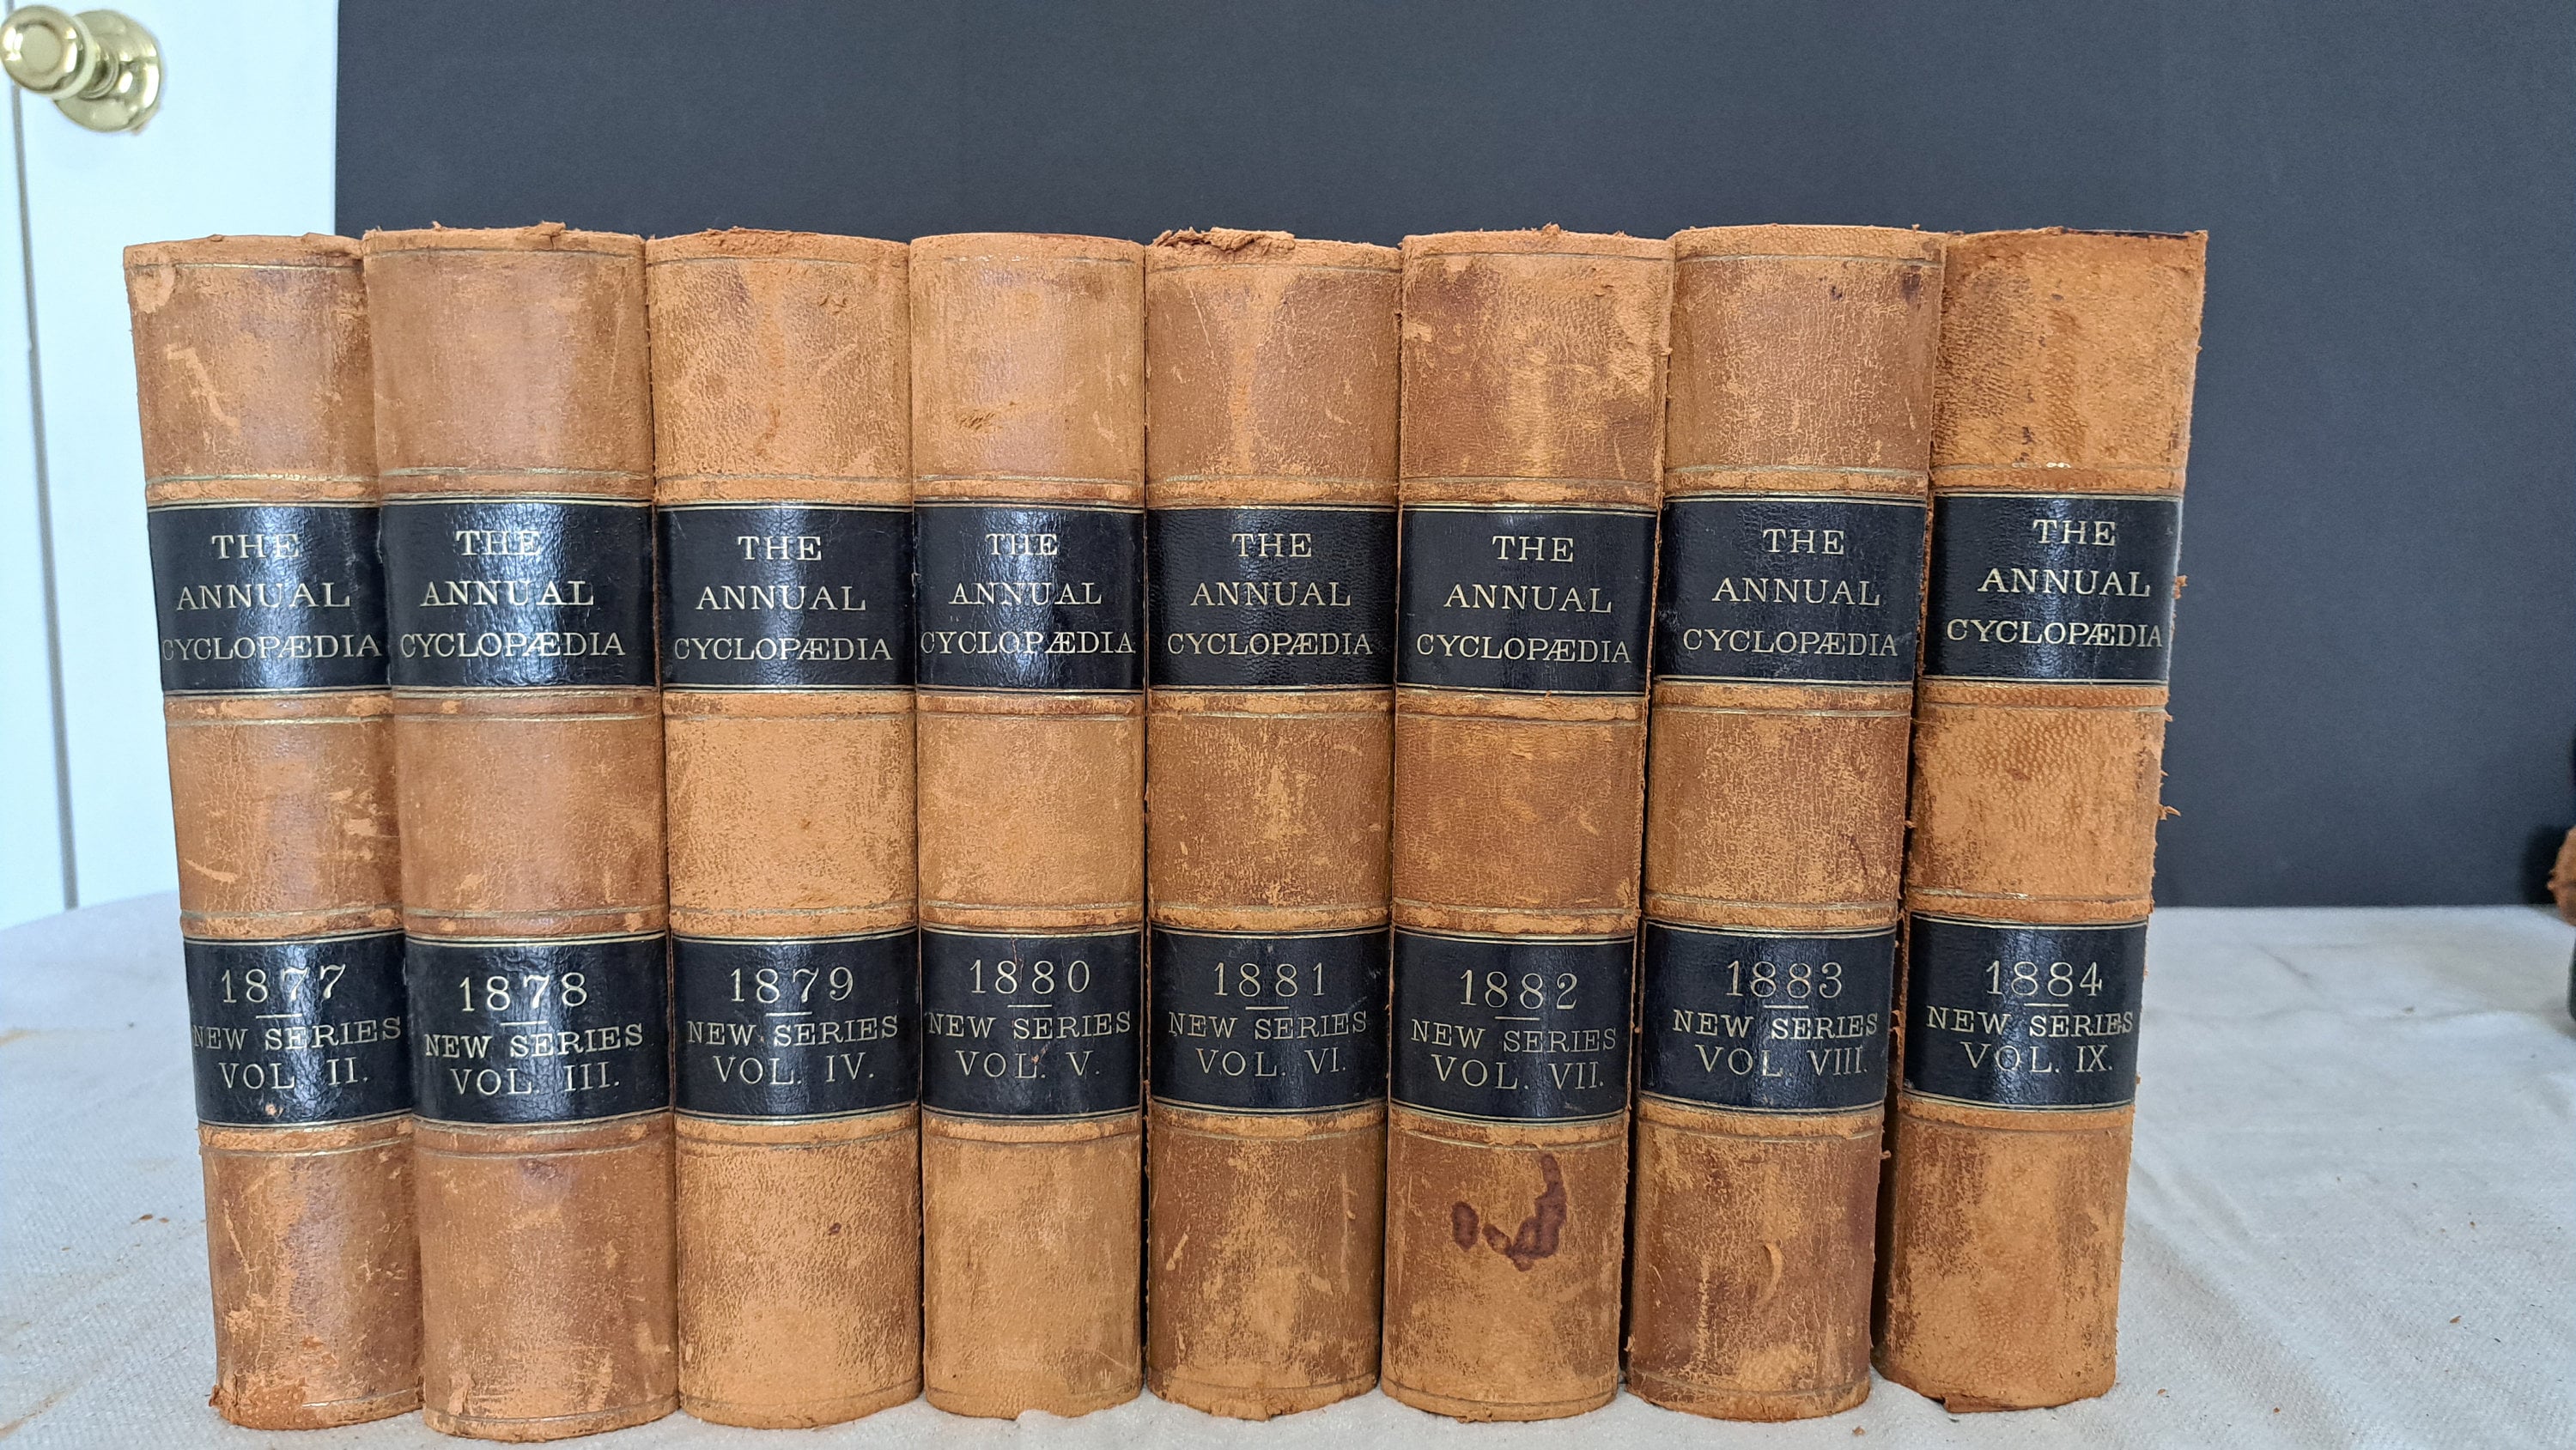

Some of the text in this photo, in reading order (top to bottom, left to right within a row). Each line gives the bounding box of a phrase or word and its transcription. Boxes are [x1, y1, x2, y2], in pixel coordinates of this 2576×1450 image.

[211, 533, 300, 560] THE
[455, 530, 541, 556] THE
[985, 532, 1059, 556] THE
[1232, 532, 1313, 558] THE
[1763, 529, 1844, 555] THE
[2032, 519, 2117, 548] THE
[738, 536, 822, 561] THE
[1492, 536, 1575, 563] THE
[176, 582, 349, 611] ANNUAL
[419, 580, 594, 607] ANNUAL
[949, 582, 1103, 606] ANNUAL
[1190, 582, 1351, 608] ANNUAL
[1711, 578, 1880, 607] ANNUAL
[1978, 567, 2150, 598] ANNUAL
[696, 585, 866, 612] ANNUAL
[1443, 584, 1613, 614] ANNUAL
[162, 634, 382, 661] CYCLOPÆDIA
[400, 632, 626, 658] CYCLOPÆDIA
[920, 631, 1136, 655] CYCLOPÆDIA
[1168, 633, 1373, 656] CYCLOPÆDIA
[1683, 629, 1899, 657] CYCLOPÆDIA
[1946, 619, 2163, 648] CYCLOPÆDIA
[674, 638, 894, 661] CYCLOPÆDIA
[1417, 634, 1631, 664] CYCLOPÆDIA
[222, 963, 346, 1004] 1877
[730, 967, 854, 1005] 1879
[970, 959, 1090, 995] 1880
[1213, 962, 1325, 998] 1881
[1460, 969, 1577, 1010] 1882
[1727, 961, 1843, 998] 1883
[1986, 960, 2103, 998] 1884
[461, 972, 587, 1013] 1878
[193, 1016, 401, 1051] NEW SERIES
[688, 1015, 898, 1047] NEW SERIES
[929, 1011, 1132, 1040] NEW SERIES
[1170, 1010, 1368, 1040] NEW SERIES
[1411, 1019, 1617, 1053] NEW SERIES
[1674, 1010, 1879, 1040] NEW SERIES
[1926, 1006, 2134, 1038] NEW SERIES
[425, 1023, 643, 1059] NEW SERIES
[713, 1052, 874, 1086] VOL. IV.
[955, 1050, 1100, 1079] VOL. V.
[1196, 1047, 1346, 1077] VOL. VI.
[1431, 1053, 1604, 1090] VOL. VII.
[1695, 1044, 1868, 1077] VOL. VIII.
[1959, 1041, 2112, 1073] VOL. IX.
